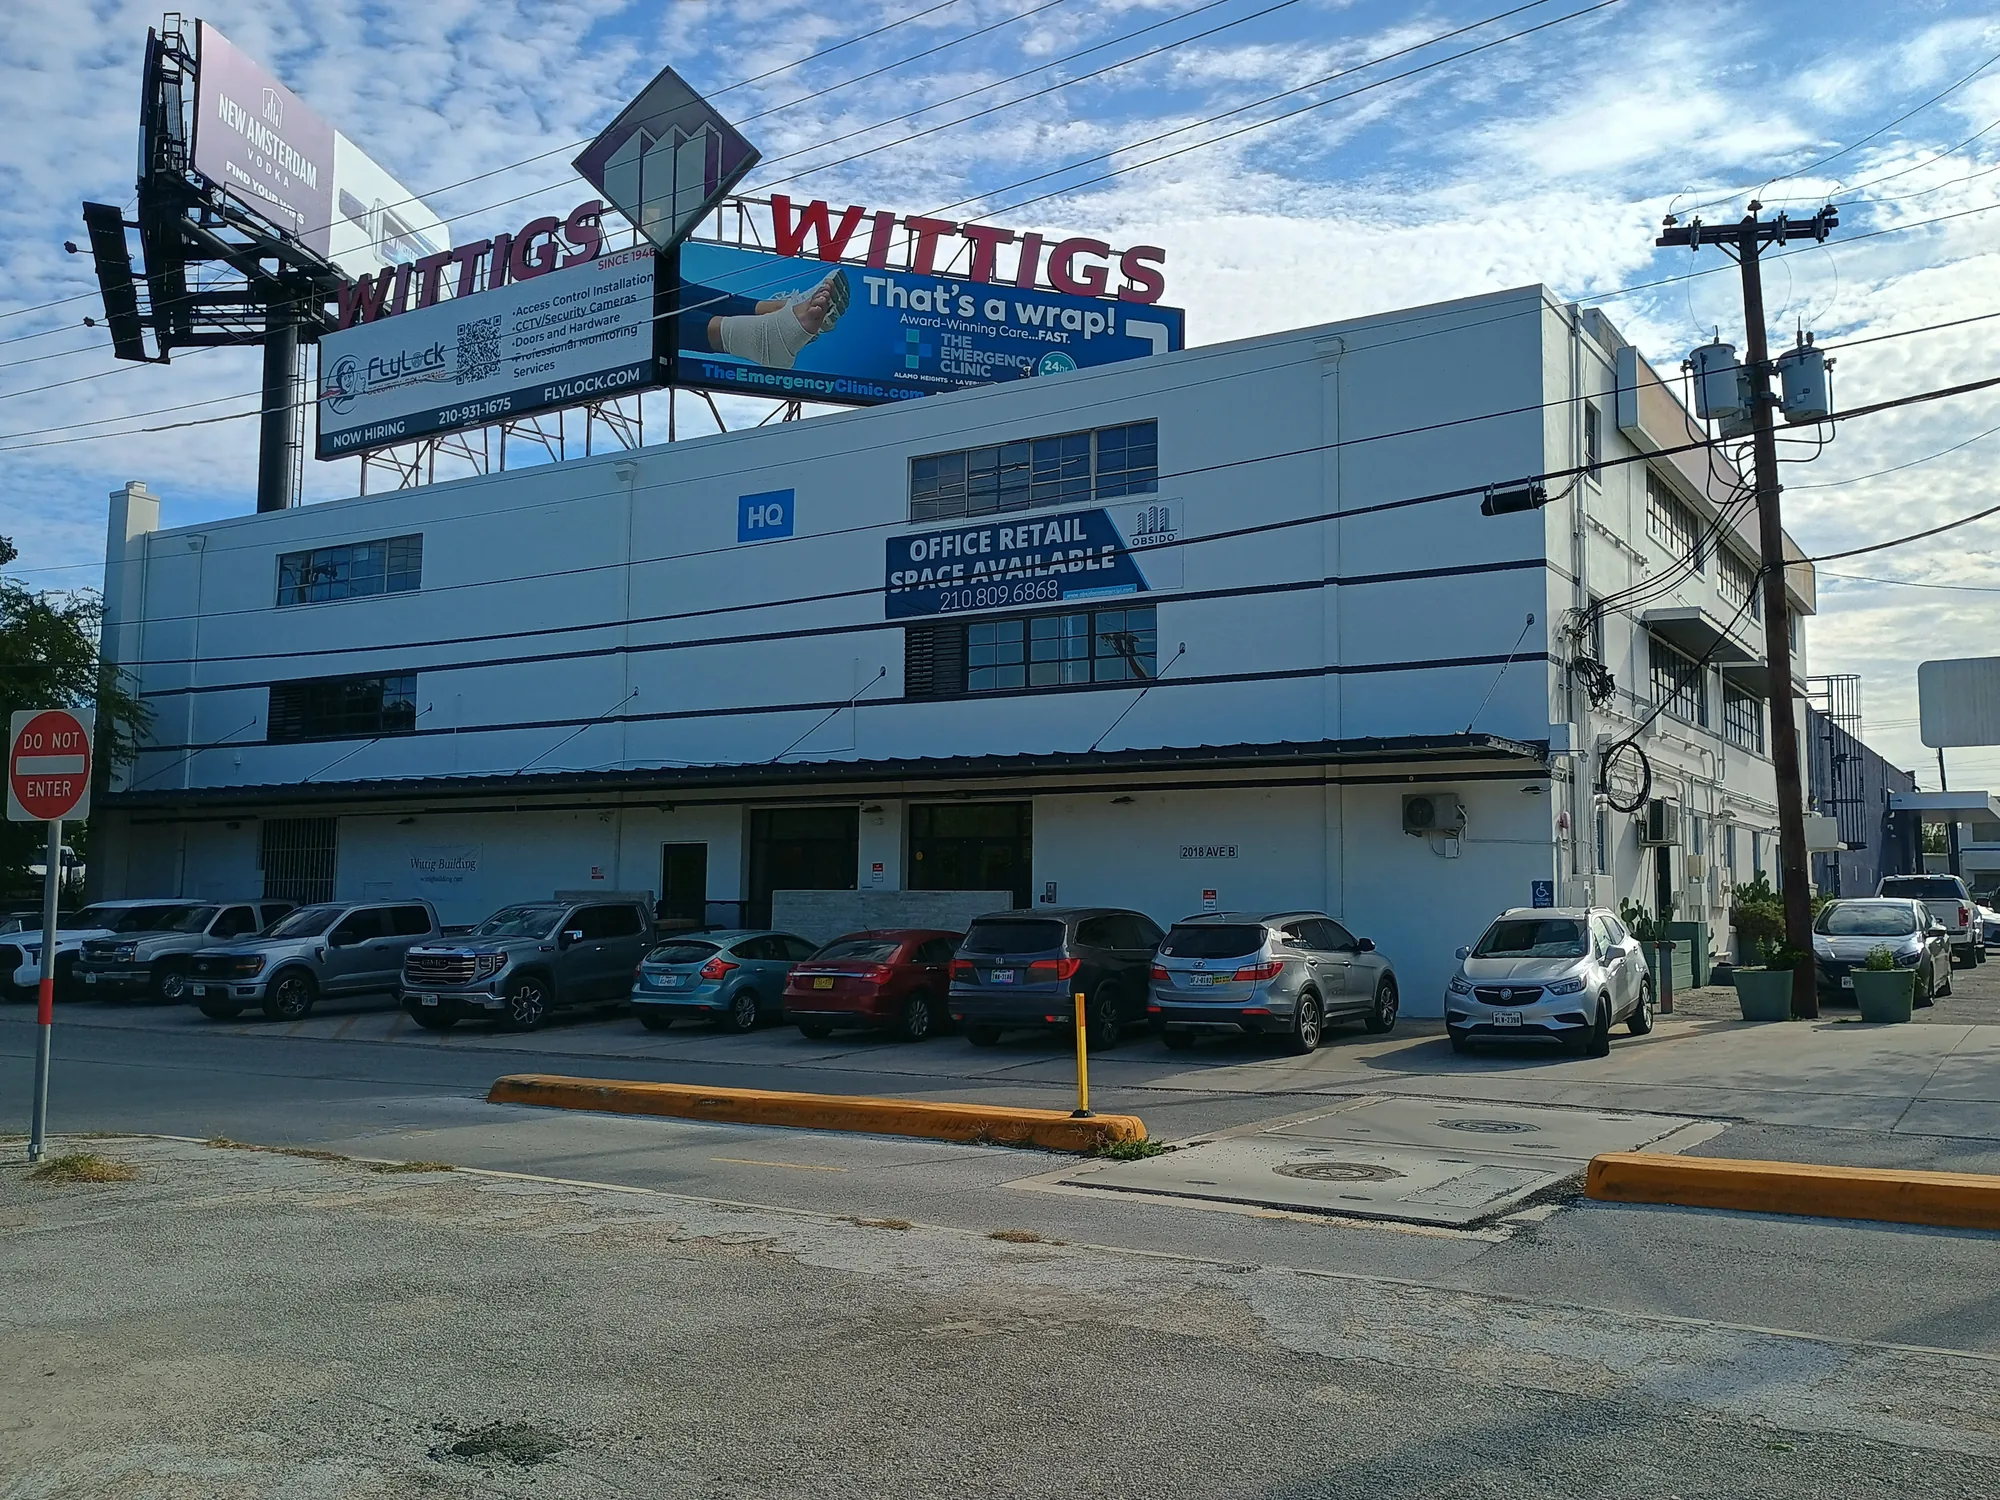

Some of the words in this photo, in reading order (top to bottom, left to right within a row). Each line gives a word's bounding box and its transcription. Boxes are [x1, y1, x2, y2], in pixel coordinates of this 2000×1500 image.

[218, 93, 247, 135] NEW
[247, 116, 317, 190] AMSTERDAM
[248, 148, 290, 188] VODKA
[226, 160, 251, 185] FIND
[252, 178, 279, 207] YOUR
[598, 254, 629, 271] SINCE
[632, 248, 656, 261] 1946
[770, 194, 1166, 304] WITTIGS
[338, 200, 602, 331] WITTIGS
[516, 300, 554, 317] Access
[553, 288, 590, 307] Control
[593, 273, 653, 298] Installation
[863, 276, 975, 317] That's
[984, 298, 1006, 321] a
[1015, 302, 1115, 340] wrap!
[516, 305, 587, 332] CCTV/Security
[589, 293, 637, 314] Cameras
[899, 313, 997, 338] Award-Winning
[516, 331, 545, 347] Doors
[547, 325, 566, 339] and
[570, 314, 620, 334] Hardware
[516, 339, 577, 362] Professional
[579, 325, 637, 347] Monitoring
[940, 332, 972, 349] THE
[513, 360, 556, 378] Services
[940, 347, 1037, 370] EMERGENCY
[940, 360, 991, 378] CLINIC
[544, 367, 640, 401] FLYLOCK.COM
[702, 363, 925, 399] TheEmergencyClinic.com
[894, 372, 918, 380] ALAMO
[920, 374, 948, 383] HEIGHTS
[438, 396, 512, 425] 210-931-1675
[333, 432, 361, 448] NOW
[365, 421, 405, 441] HIRING
[747, 503, 783, 529] HQ
[910, 530, 991, 562] OFFICE
[999, 518, 1087, 550] RETAIL
[1132, 534, 1175, 546] OBSIDO
[890, 563, 964, 594] SPACE
[971, 545, 1115, 585] AVAILABLE
[940, 579, 1058, 611] 210.809.6868
[24, 733, 43, 749] DO
[52, 732, 79, 748] NOT
[27, 781, 71, 797] ENTER
[410, 858, 436, 872] Wittig
[438, 858, 477, 871] Building
[1182, 846, 1204, 857] 2018
[1206, 846, 1225, 857] AVE
[1228, 846, 1236, 857] B
